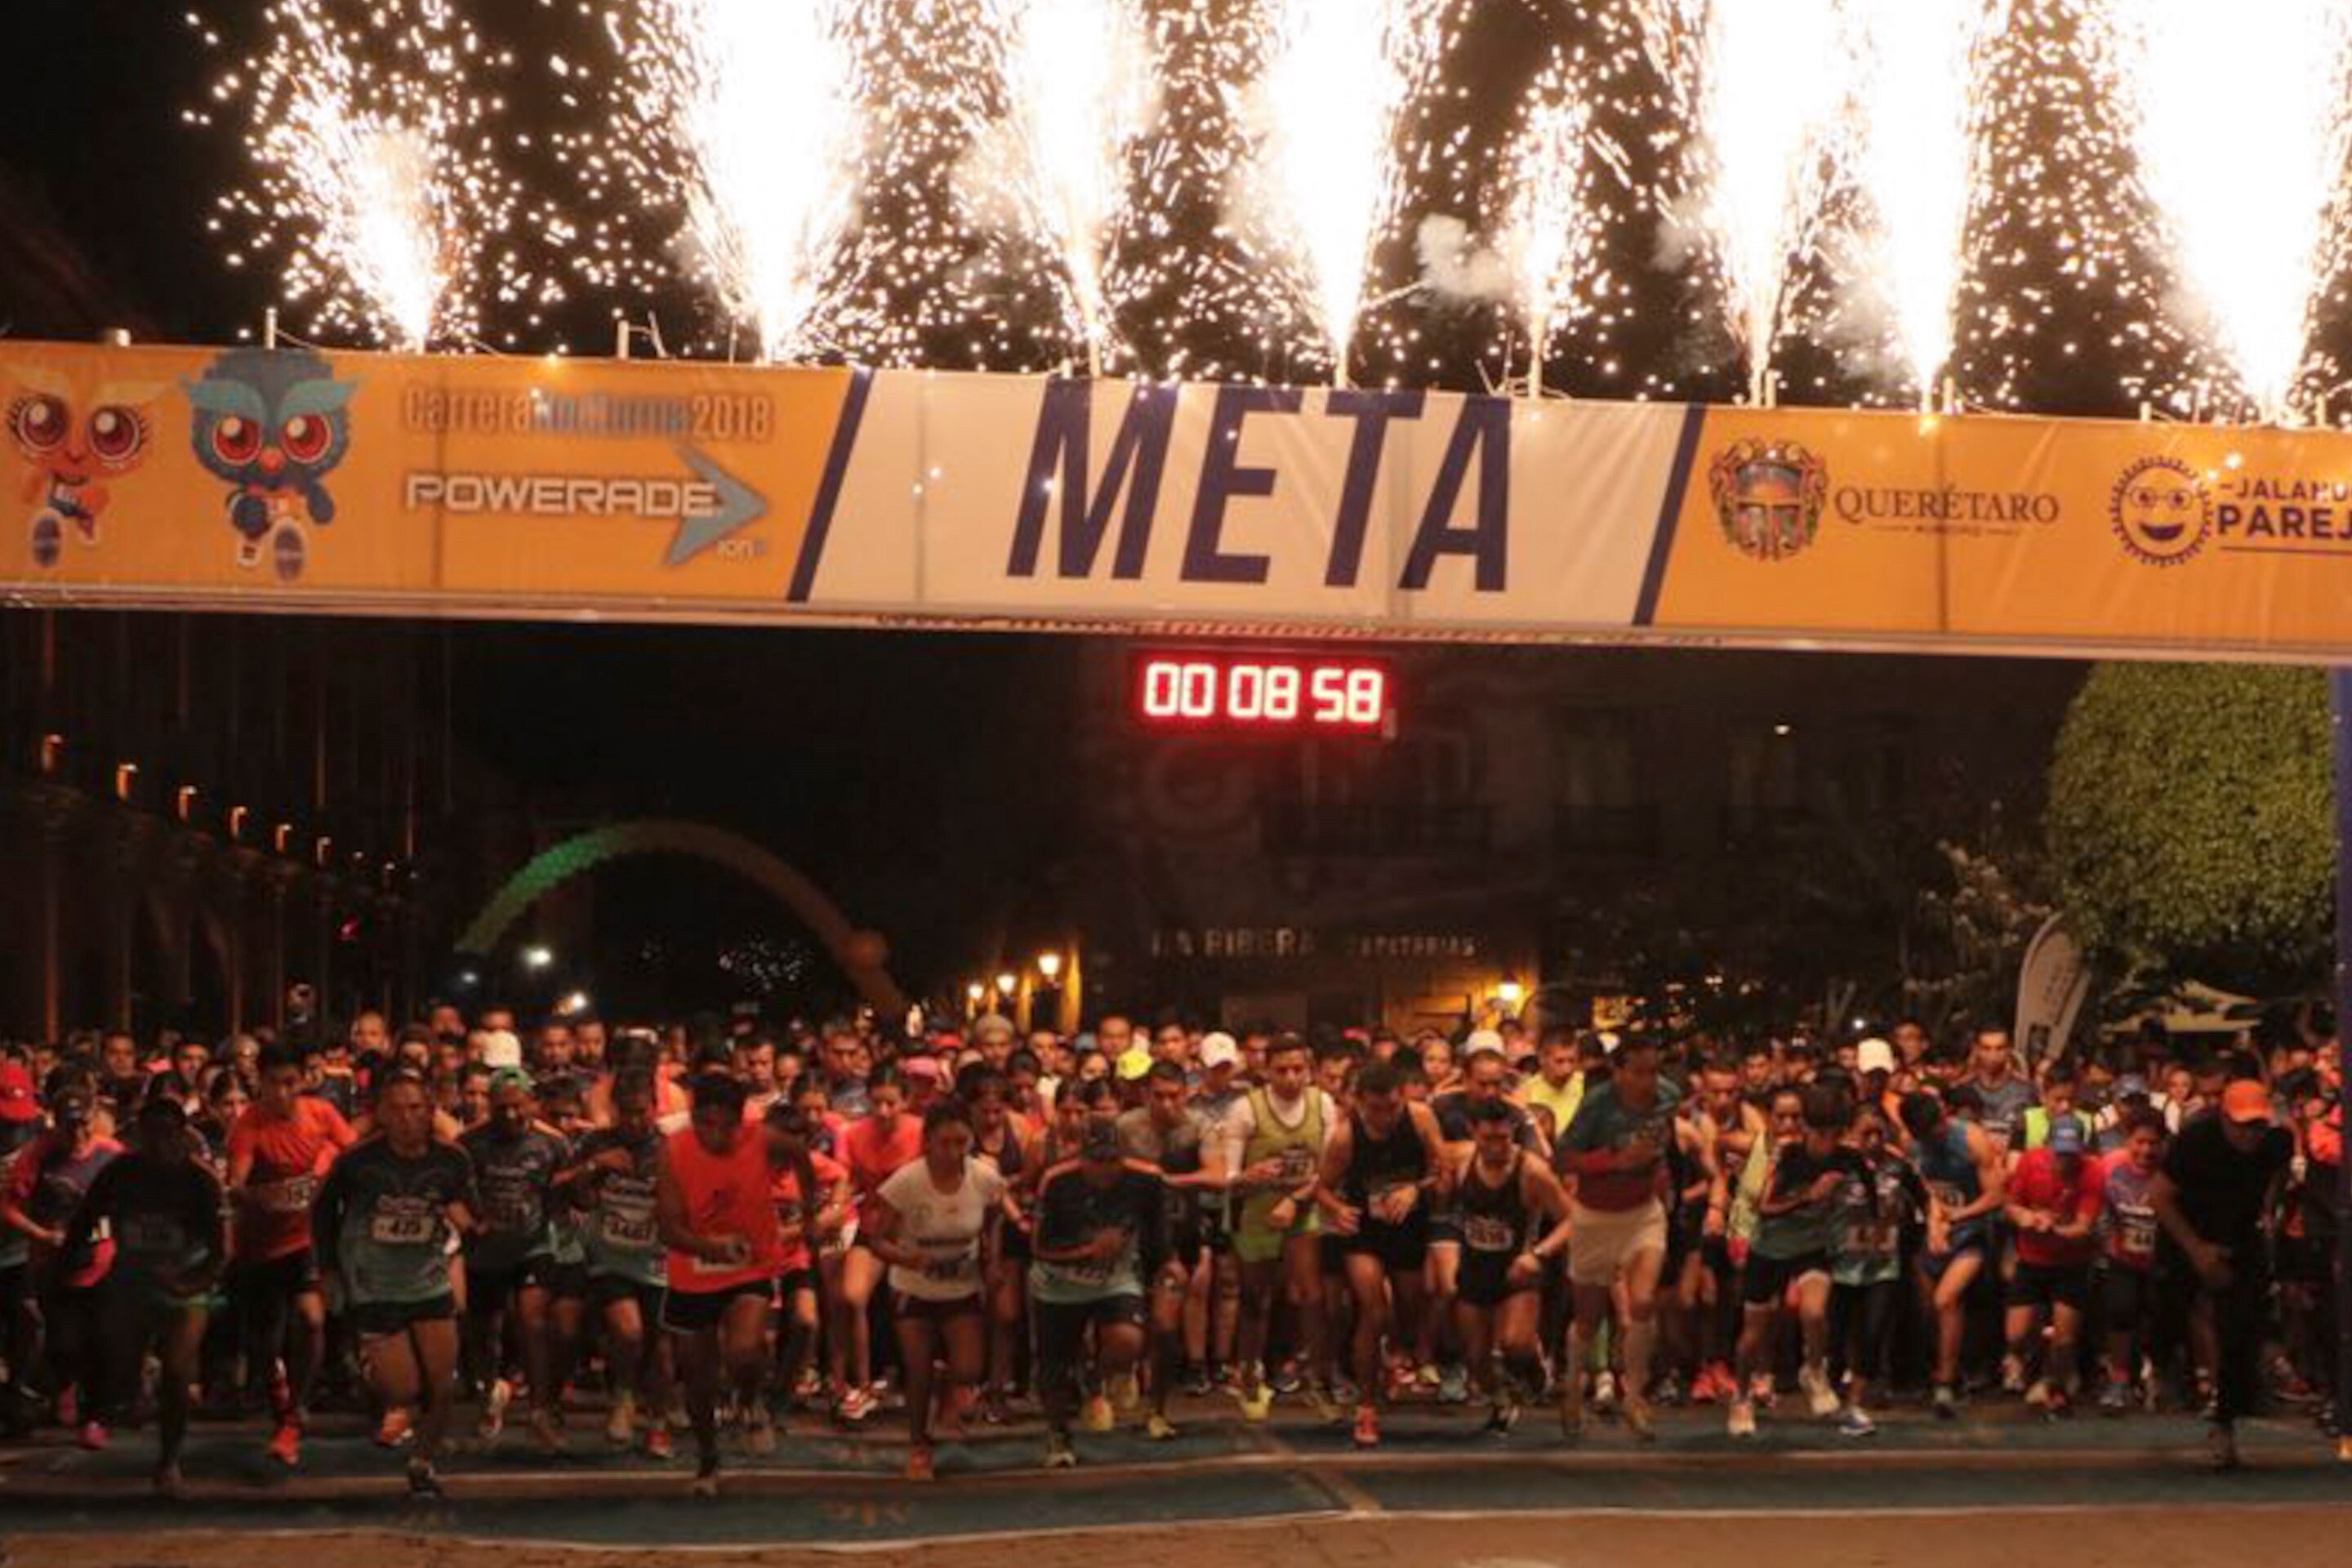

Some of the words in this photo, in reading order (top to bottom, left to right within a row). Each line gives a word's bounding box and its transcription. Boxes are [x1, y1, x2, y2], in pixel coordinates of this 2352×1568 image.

[407, 474, 716, 517] POWERADE
[1007, 374, 1511, 591] META
[1834, 482, 2060, 524] QUERÉTARO
[1143, 662, 1215, 716] 00
[1227, 665, 1300, 719] 08
[1312, 667, 1383, 723] 58
